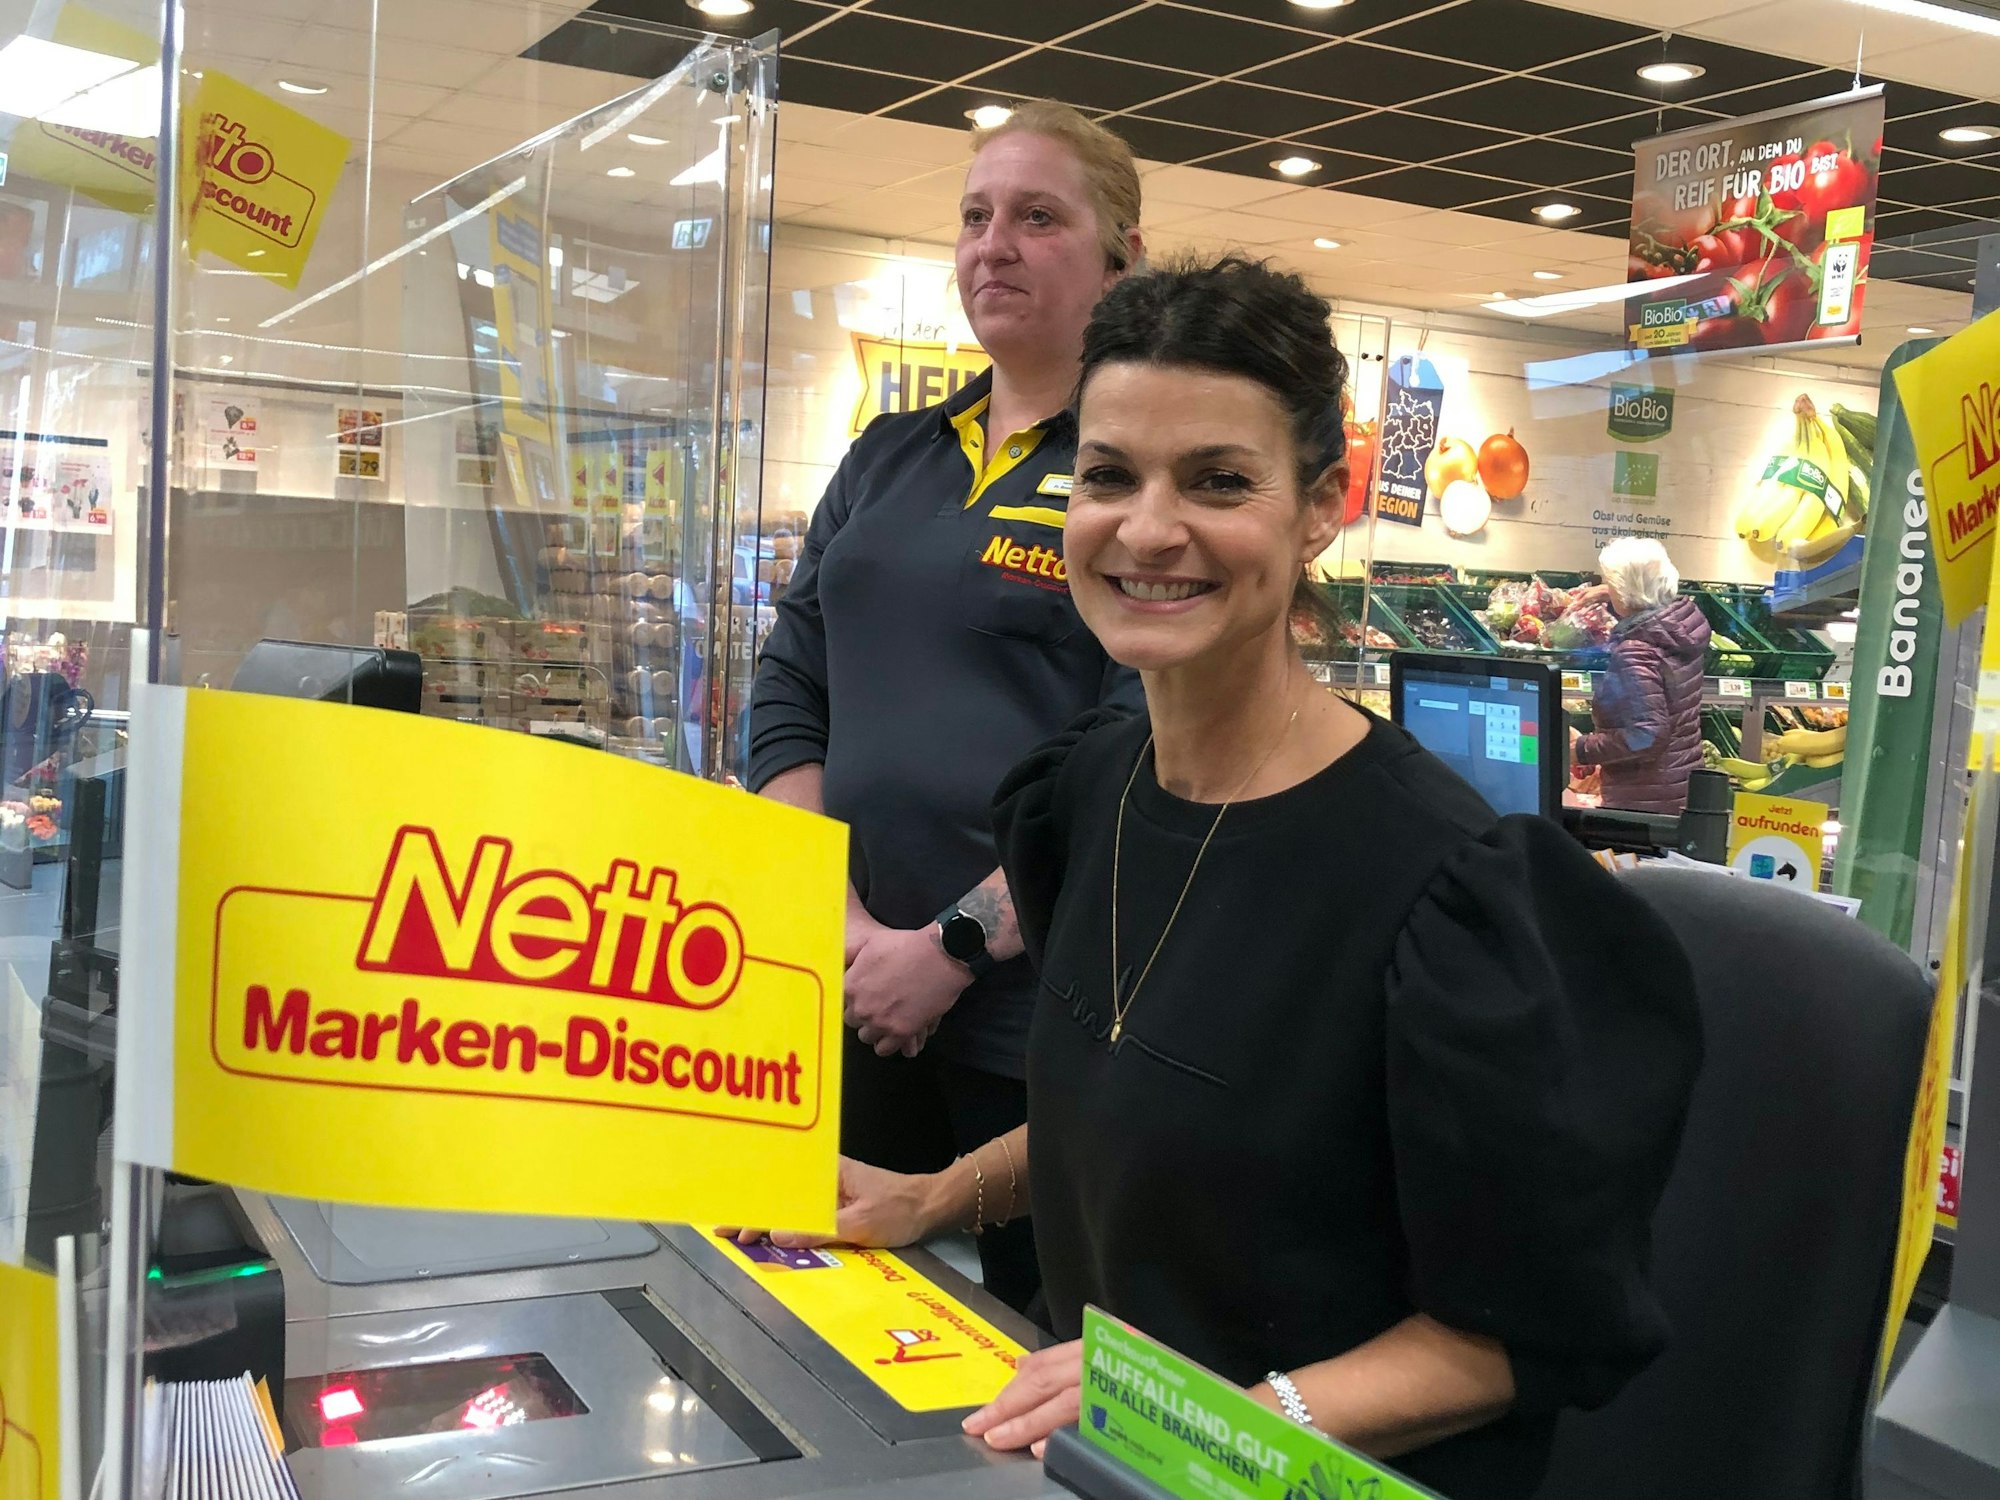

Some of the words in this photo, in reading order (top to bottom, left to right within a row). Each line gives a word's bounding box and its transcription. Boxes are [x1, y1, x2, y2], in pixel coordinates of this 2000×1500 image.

[1656, 149, 1691, 182] DER
[1739, 147, 1755, 164] AN
[1758, 141, 1783, 160] DEM
[1786, 137, 1803, 154] DU
[1674, 177, 1716, 211] REIF
[1721, 167, 1762, 202] FÜR
[1769, 159, 1806, 195] BIO
[1810, 152, 1840, 175] BIST.
[1644, 307, 1683, 326] BioBio
[1654, 329, 1665, 338] 20
[880, 361, 977, 412] HEI
[1614, 394, 1668, 421] BioBio
[1371, 480, 1389, 494] US
[1391, 483, 1422, 500] DEINER
[1376, 495, 1419, 518] EGION
[1592, 527, 1608, 535] aus
[1593, 510, 1614, 521] Obst
[1616, 513, 1634, 523] und
[1636, 513, 1671, 526] Gemüse
[979, 535, 1068, 580] Netto
[1877, 468, 1929, 697] Bananen
[1737, 815, 1819, 837] aufrunden
[1768, 804, 1792, 815] Jetzt
[356, 824, 744, 1010] Netto
[243, 984, 802, 1105] Marken-Discount
[906, 1291, 999, 1350] kontrolliert?
[1091, 1346, 1231, 1443] AUFFALLEND
[1236, 1431, 1289, 1478] GUT
[1120, 1388, 1157, 1424] ALLE
[1162, 1414, 1261, 1487] BRANCHEN!
